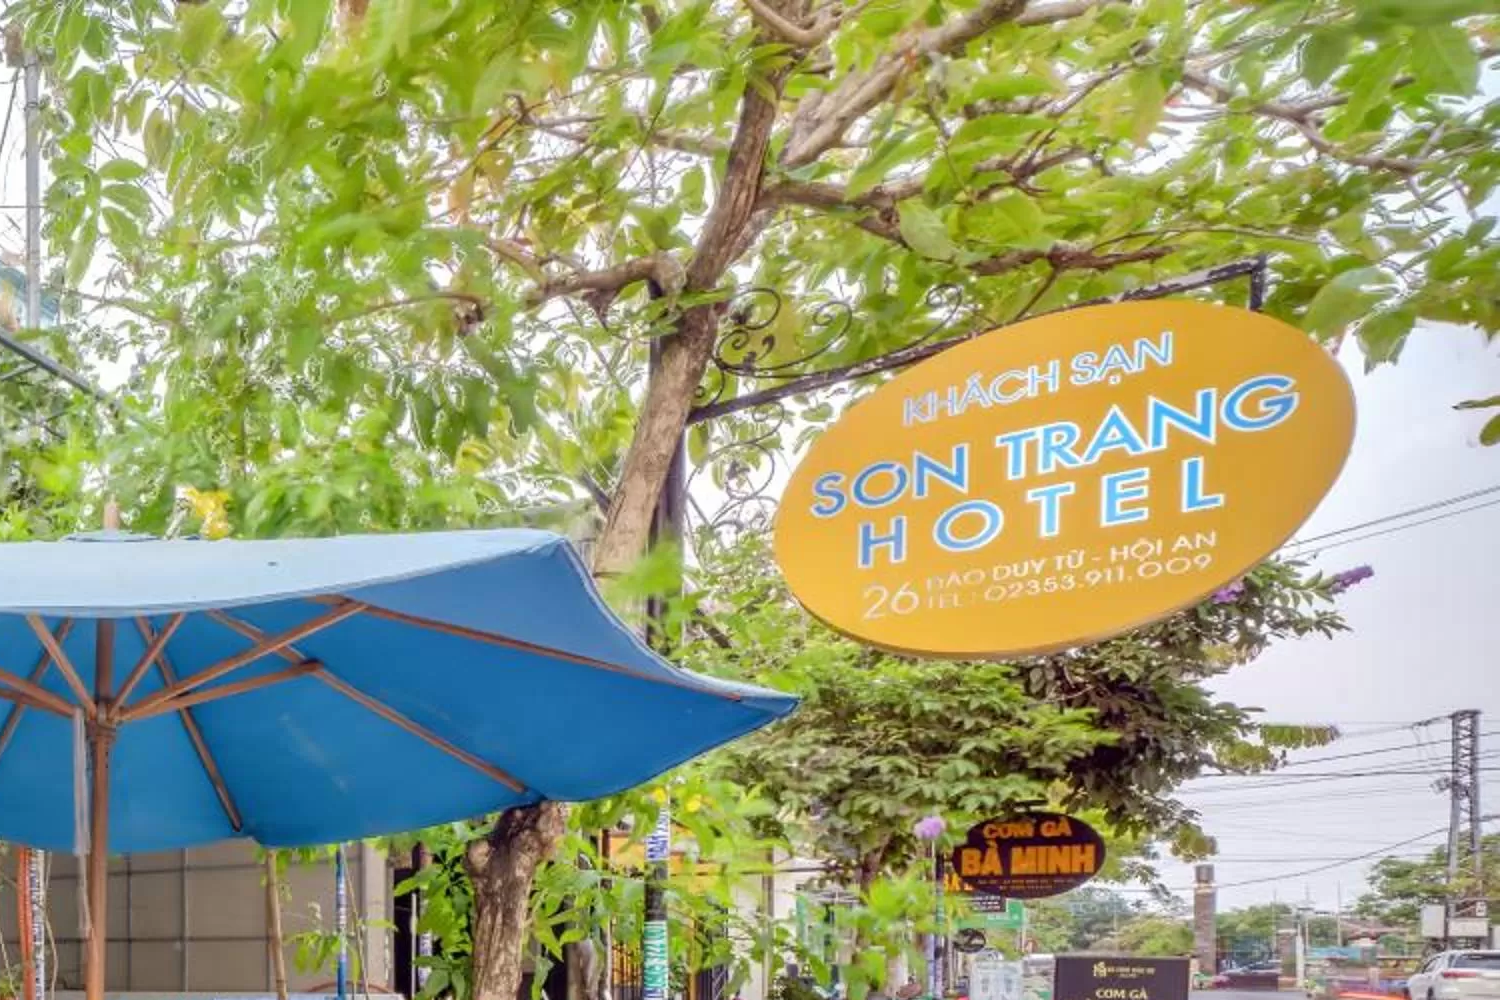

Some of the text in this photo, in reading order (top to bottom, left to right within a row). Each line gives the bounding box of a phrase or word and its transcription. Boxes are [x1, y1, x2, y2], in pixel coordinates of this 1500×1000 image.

[903, 331, 1174, 427] KHÁCH SẠN
[996, 375, 1300, 482] TRANG
[857, 456, 1226, 570] HOTEL
[992, 557, 1047, 582] DUY
[1172, 531, 1217, 553] AN
[862, 582, 920, 622] 26
[961, 839, 1096, 876] BÀ MINH
